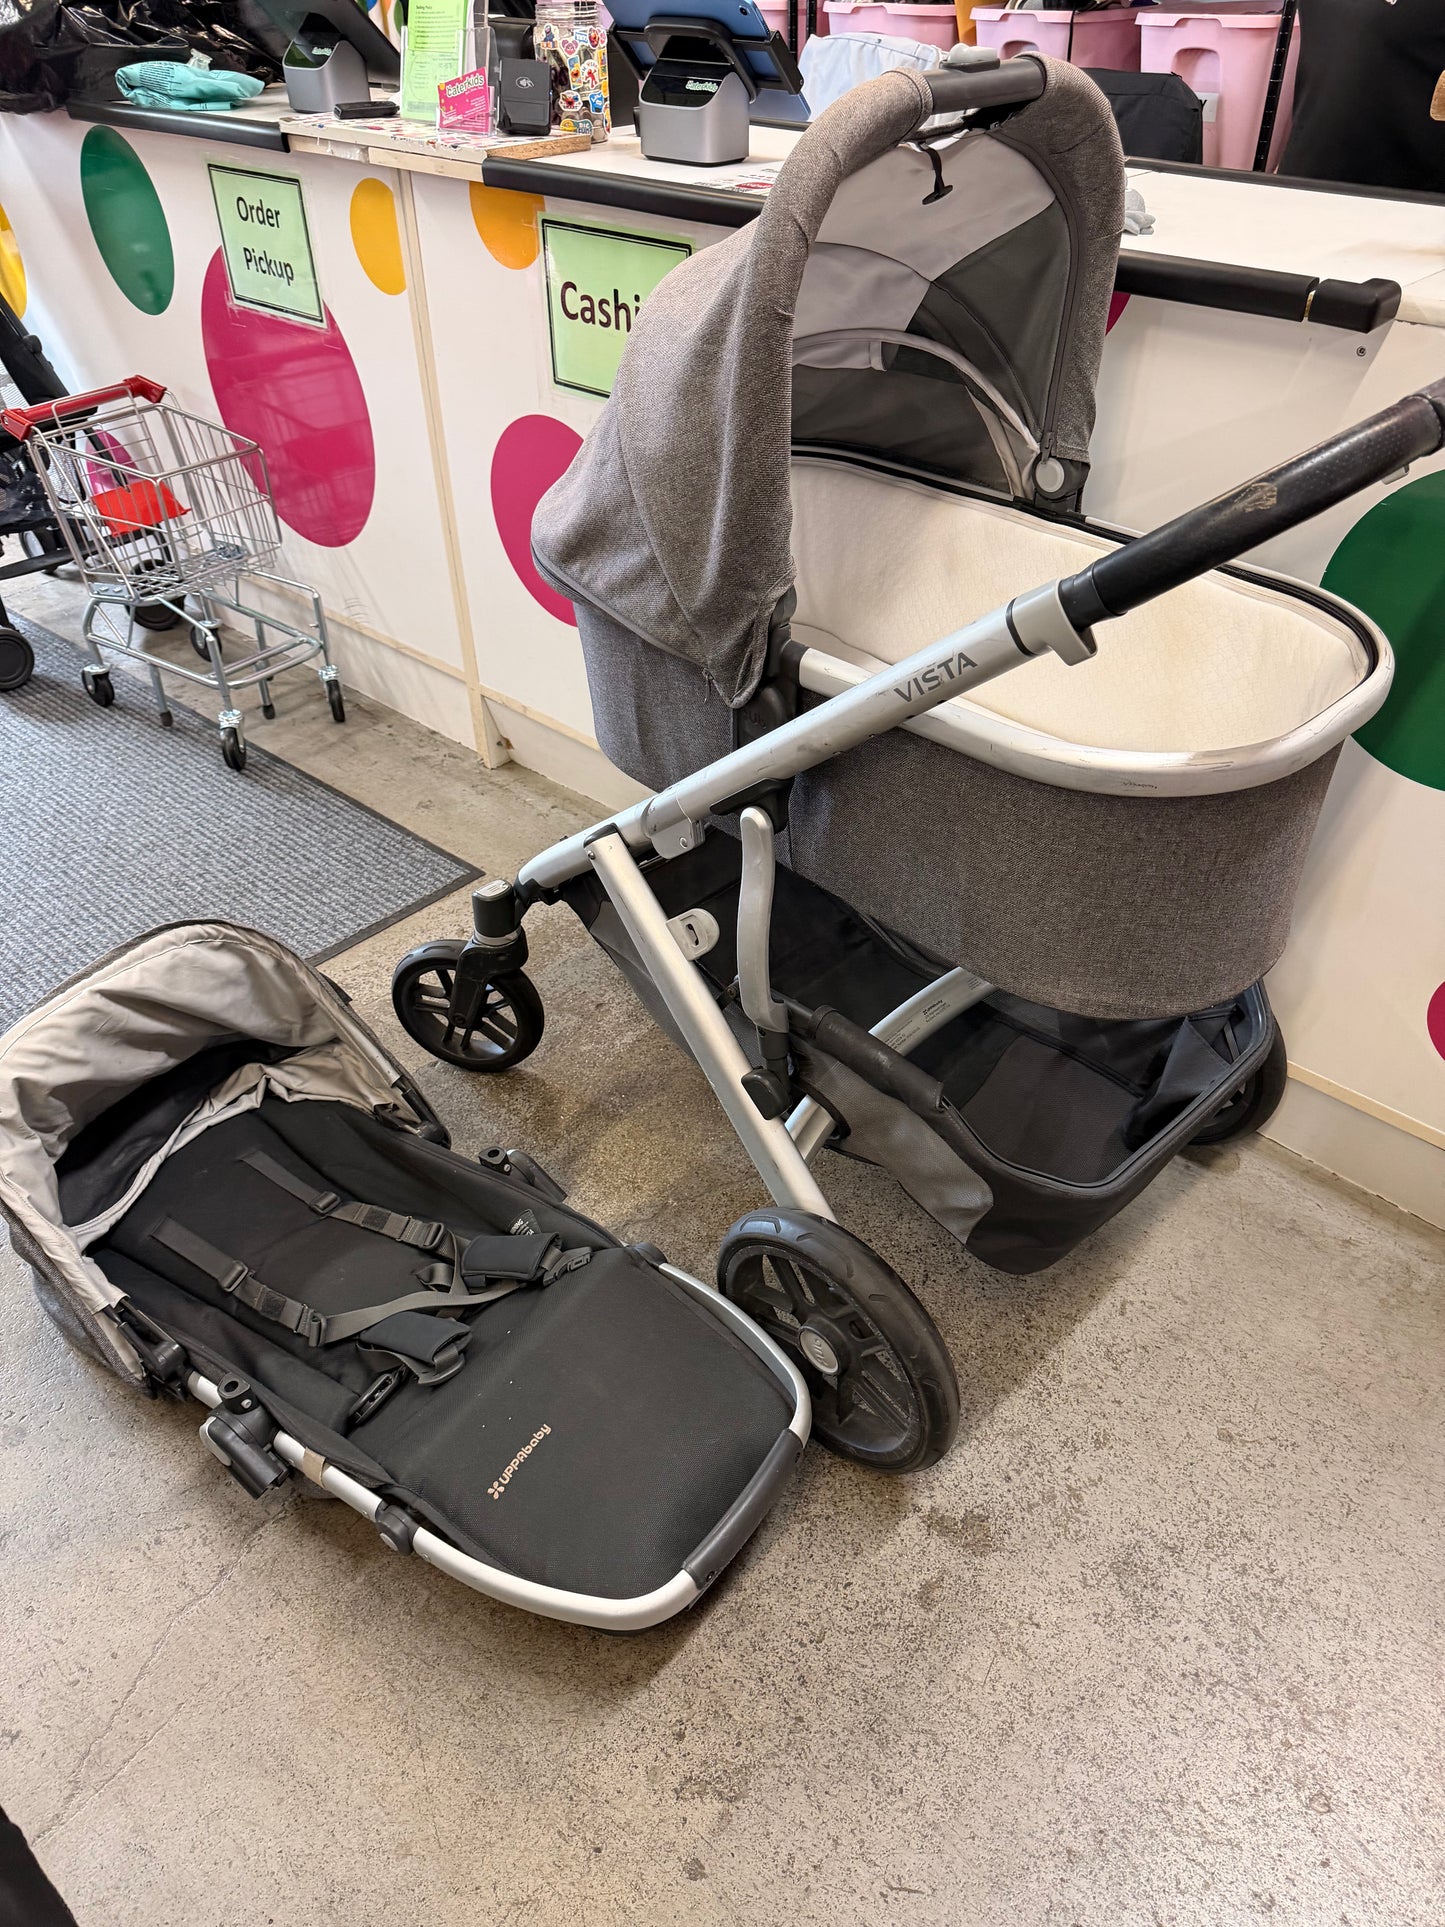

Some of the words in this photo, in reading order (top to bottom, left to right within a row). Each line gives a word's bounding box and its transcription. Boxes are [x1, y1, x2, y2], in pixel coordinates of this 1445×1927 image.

[236, 196, 281, 229] Order
[243, 246, 294, 286] Pickup
[893, 651, 978, 703] VISTA
